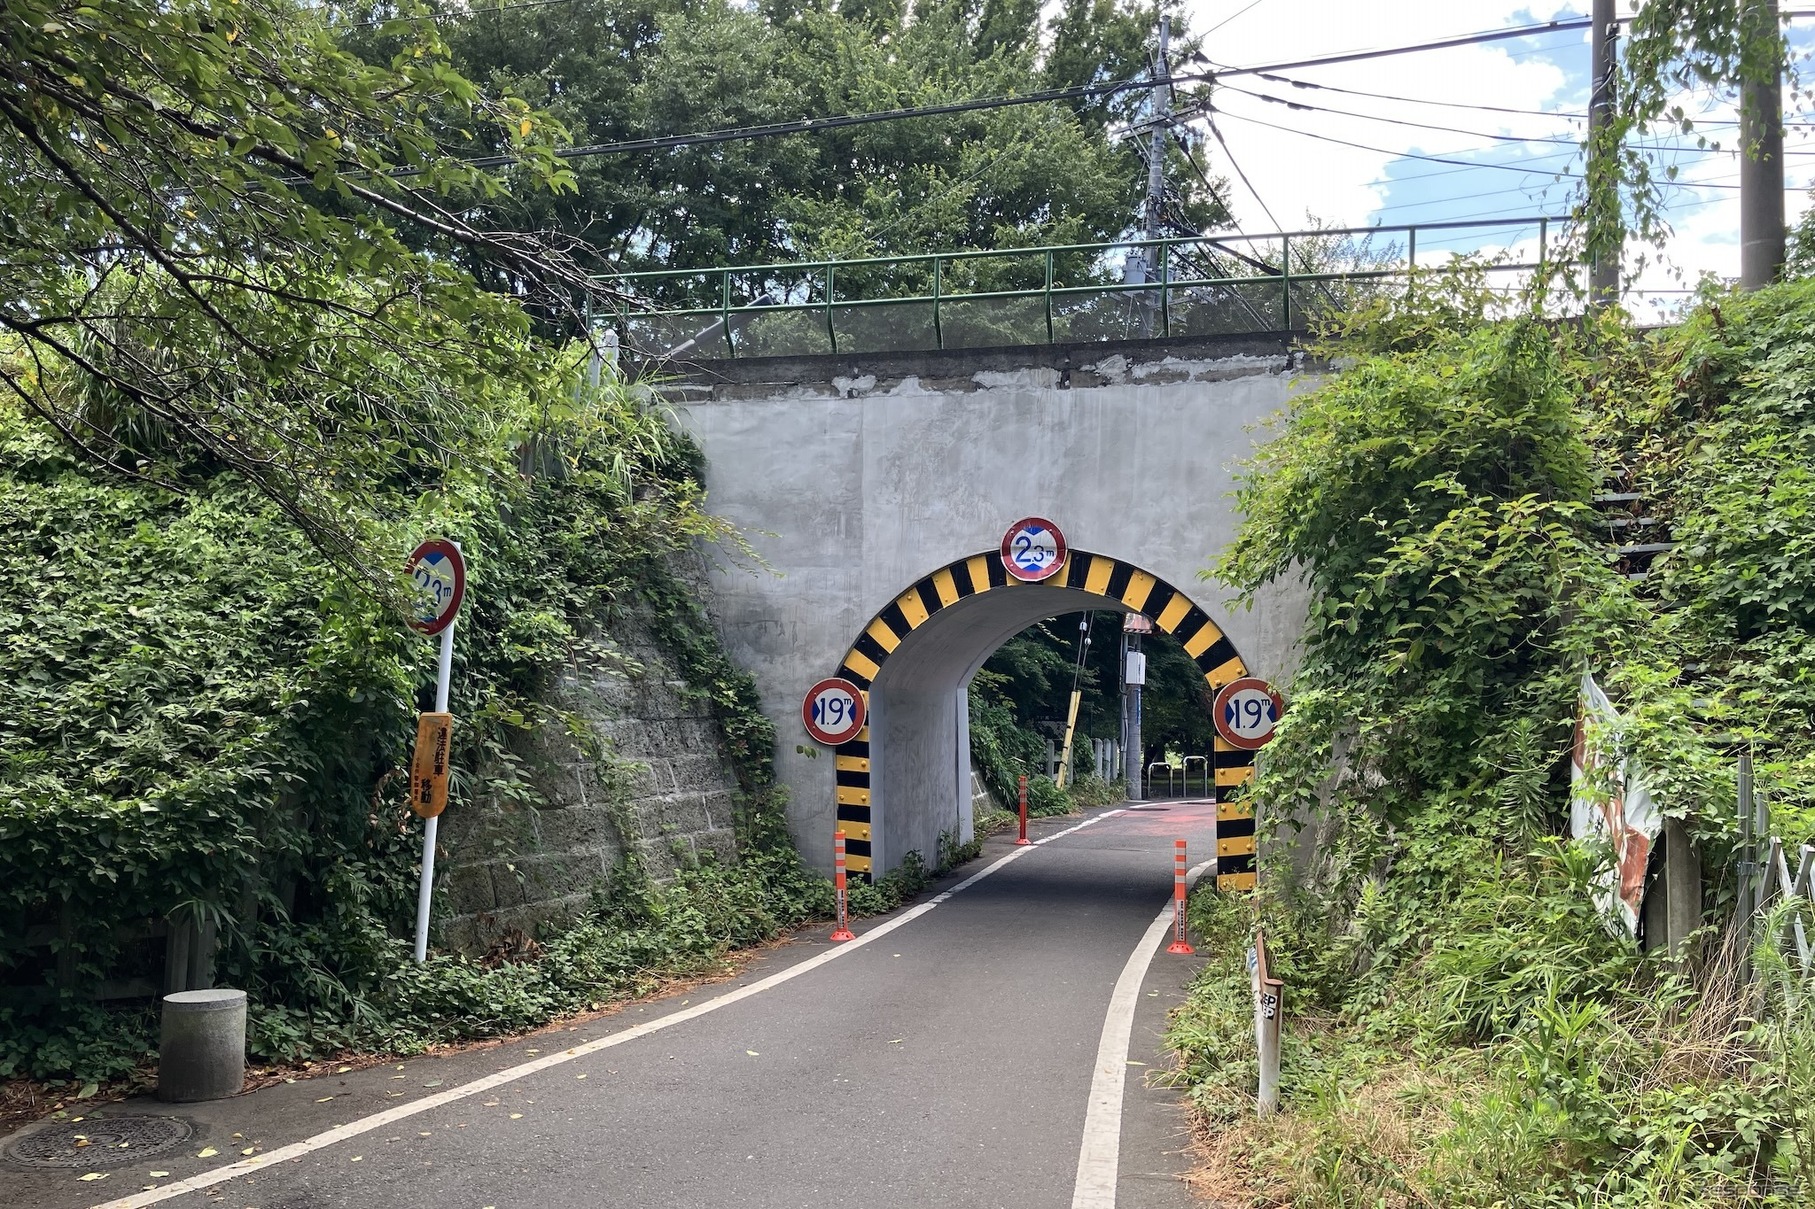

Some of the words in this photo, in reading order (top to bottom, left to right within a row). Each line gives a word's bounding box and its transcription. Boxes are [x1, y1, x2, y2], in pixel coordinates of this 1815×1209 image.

[1015, 536, 1055, 562] 2.3m
[820, 697, 852, 725] 1.9m
[1234, 698, 1270, 729] 1.9m
[433, 727, 447, 777] 違法駐車
[420, 778, 432, 804] 移動
